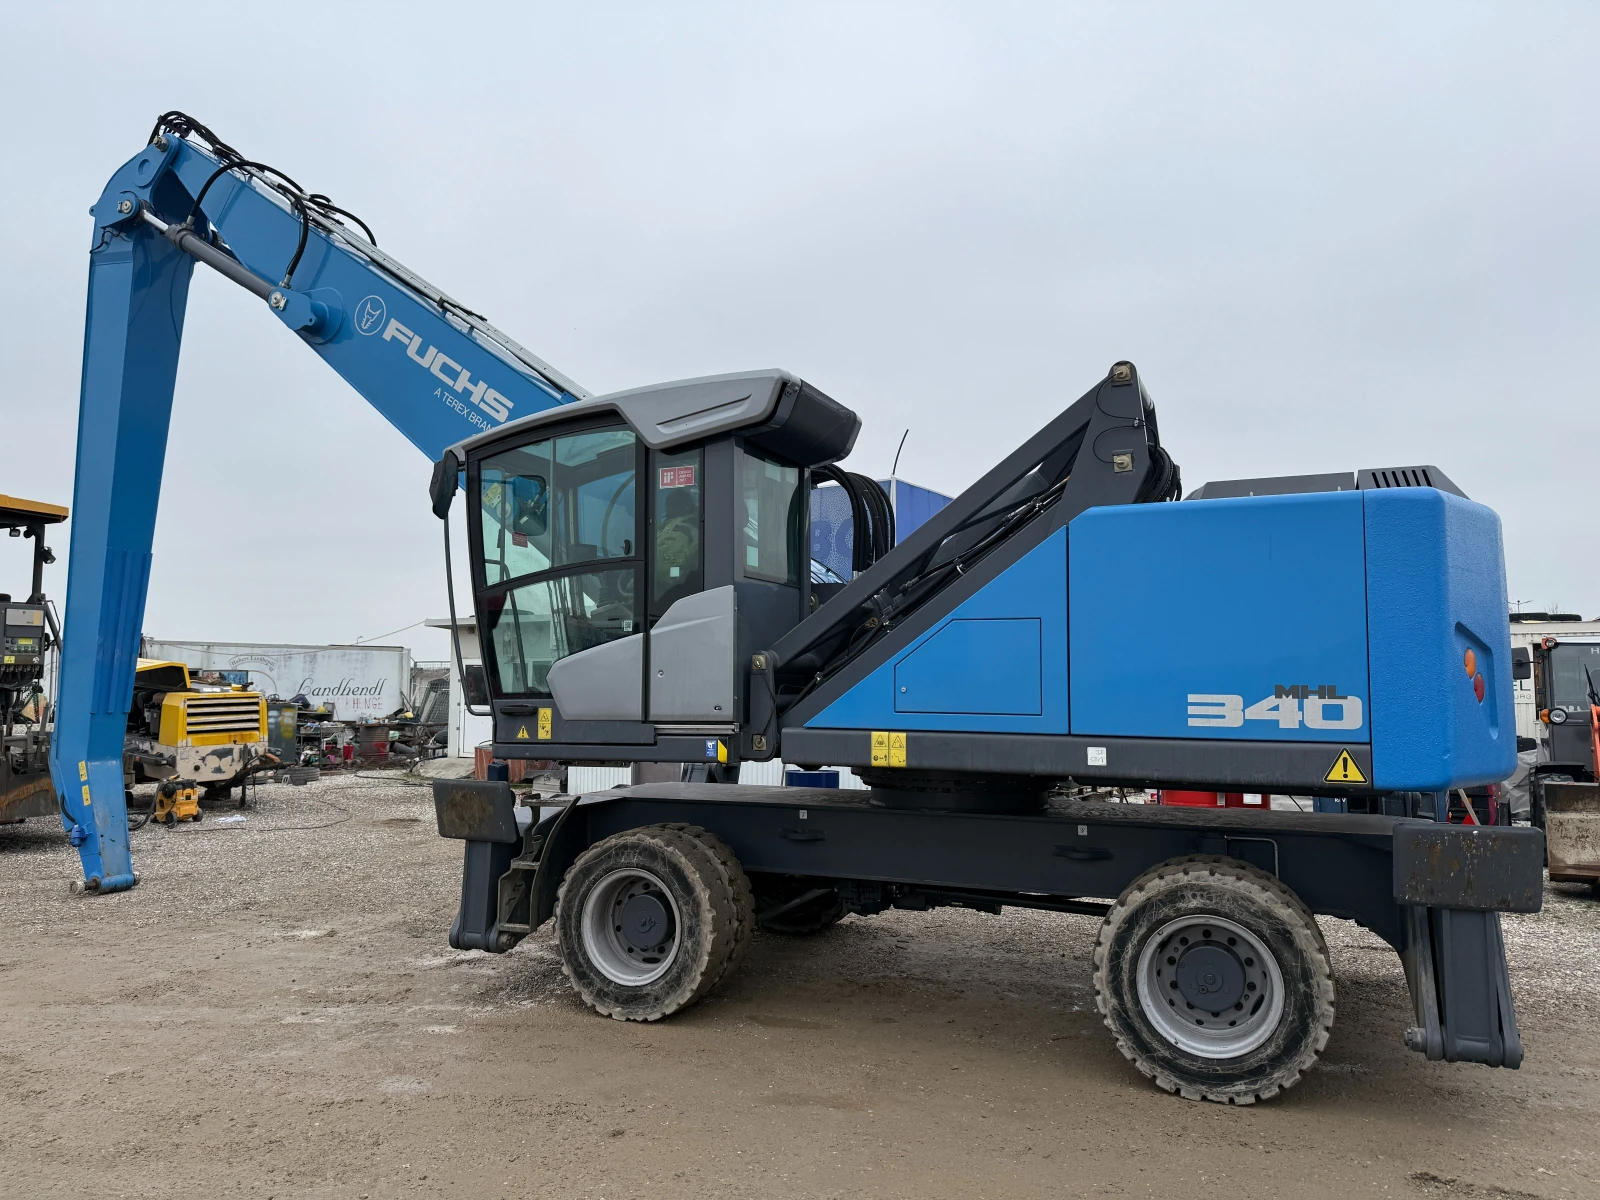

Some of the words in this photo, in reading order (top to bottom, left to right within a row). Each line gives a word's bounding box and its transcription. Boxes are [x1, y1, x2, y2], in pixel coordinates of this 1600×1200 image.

[382, 318, 515, 423] FUCHS
[433, 388, 442, 398] A
[443, 391, 470, 418] TEREX
[468, 411, 496, 432] BRAN
[298, 677, 388, 697] Landhendl
[1275, 684, 1348, 700] MHL
[1187, 693, 1363, 730] 340
